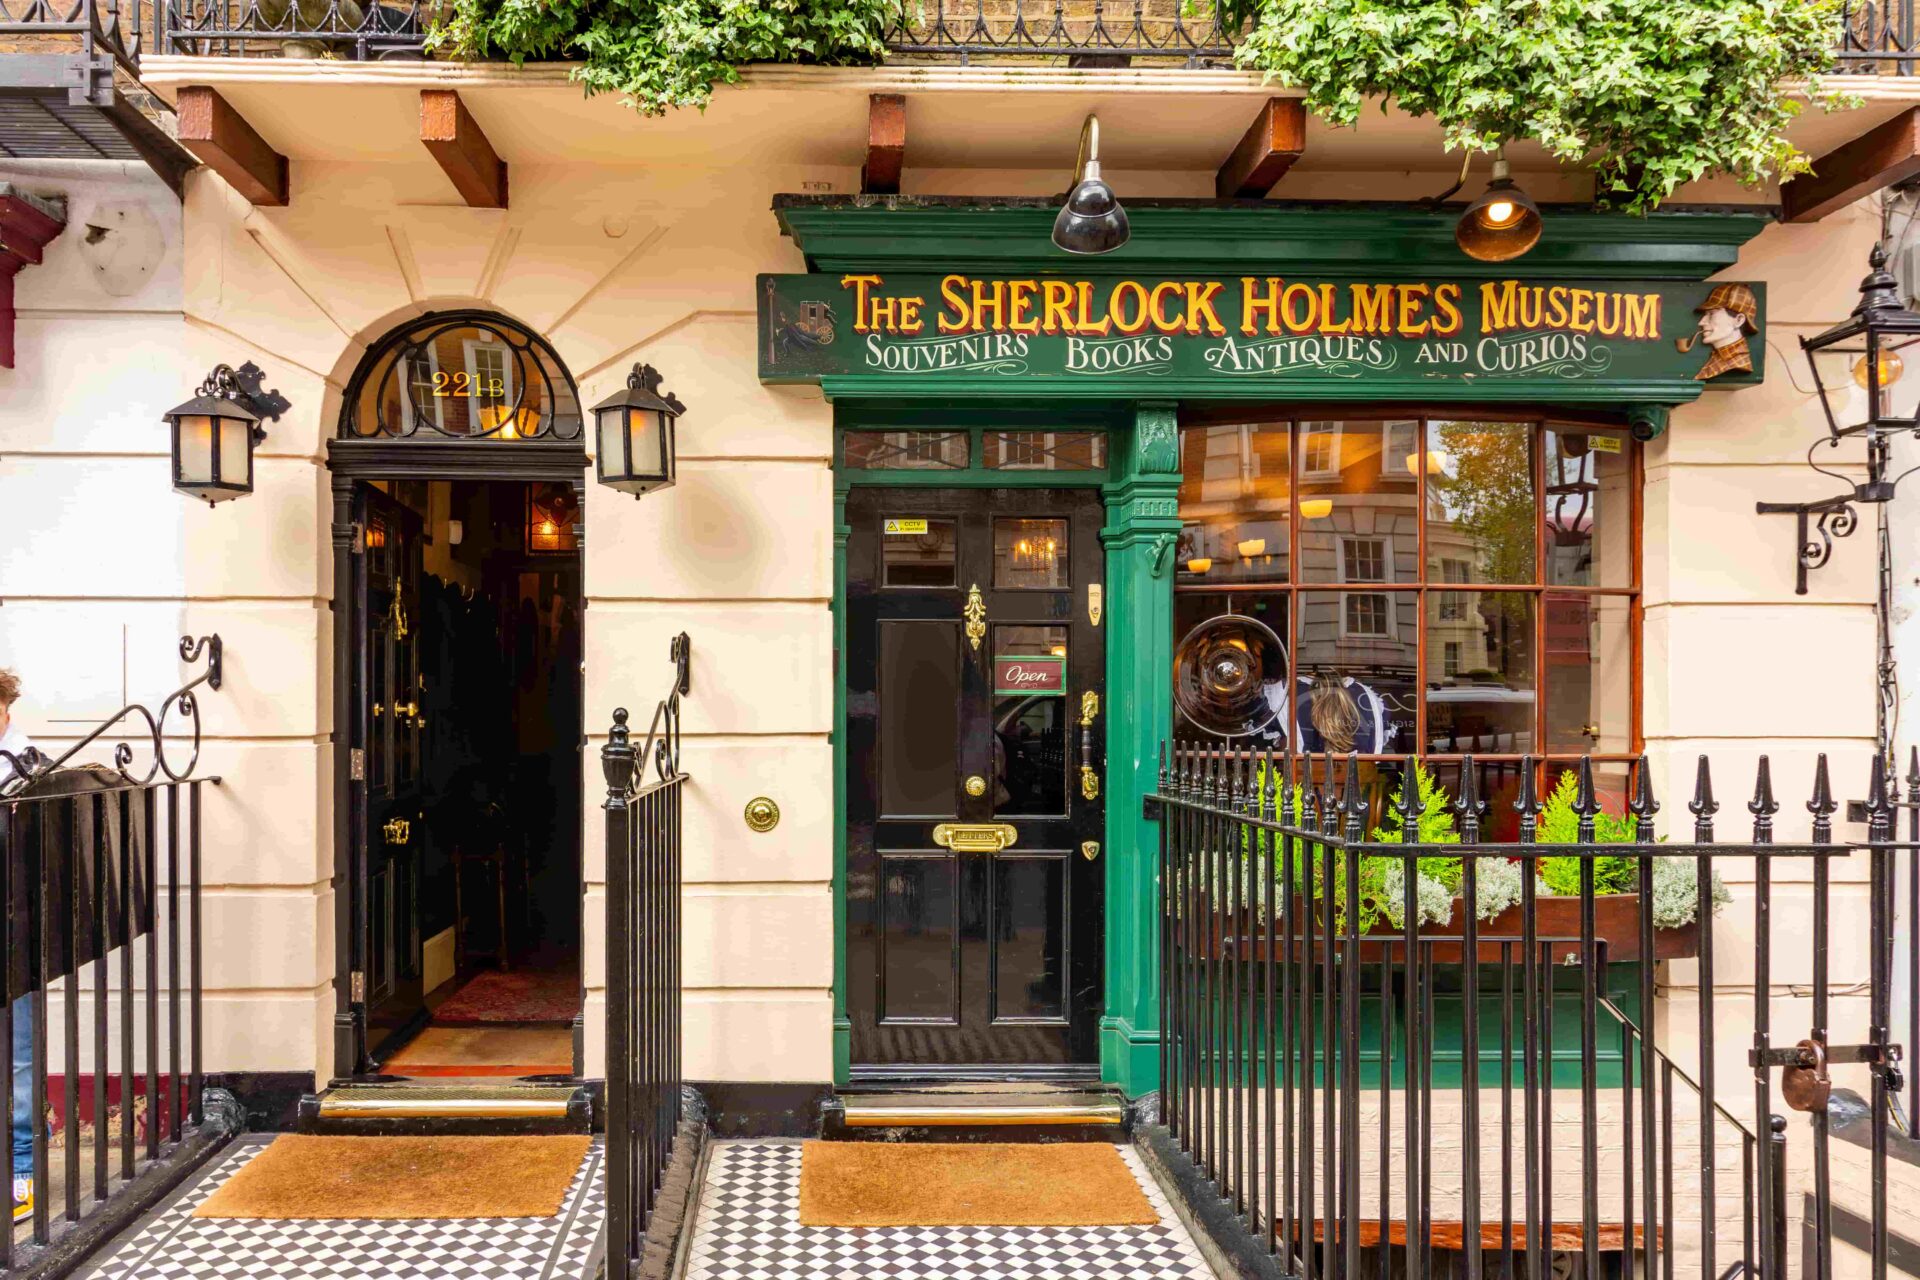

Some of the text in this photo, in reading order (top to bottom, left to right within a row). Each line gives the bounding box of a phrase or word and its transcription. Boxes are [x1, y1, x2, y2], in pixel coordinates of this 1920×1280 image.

[938, 275, 1227, 336] SHERLOCK
[1240, 277, 1463, 339] HOLMES
[1479, 280, 1661, 340] MUSEUM
[865, 333, 1587, 371] SOUVENIRS BOOKS ANTIQUES AND CURIOS
[432, 371, 505, 397] 221B
[1006, 665, 1048, 684] Open
